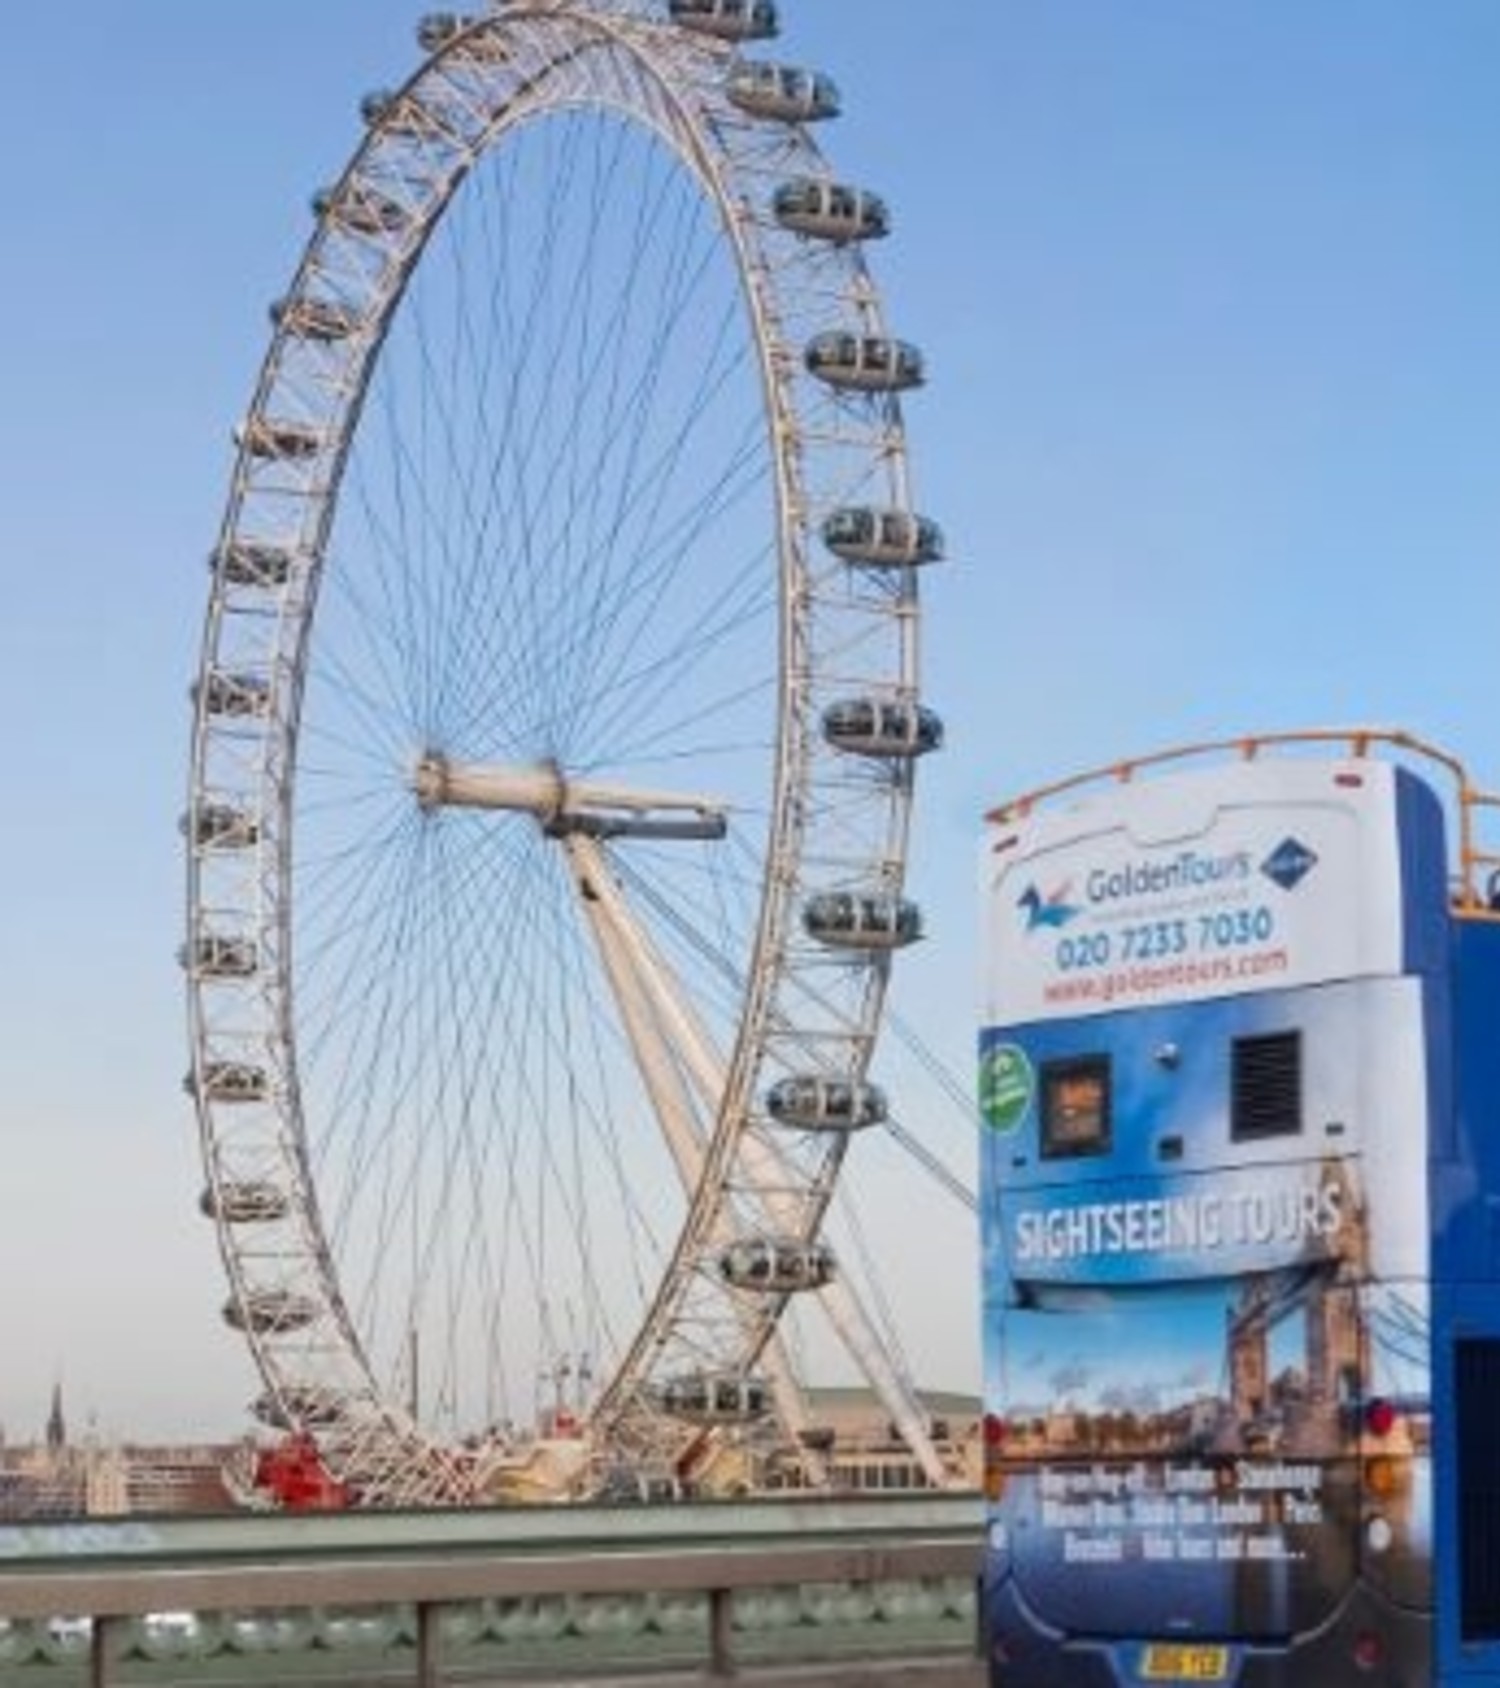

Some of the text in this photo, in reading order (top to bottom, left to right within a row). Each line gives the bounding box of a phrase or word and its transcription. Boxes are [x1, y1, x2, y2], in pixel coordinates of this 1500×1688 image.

[1055, 933, 1111, 971] 020
[1119, 920, 1187, 960] 7233
[1198, 905, 1273, 950] 7030
[1043, 947, 1289, 1003] www.goldentours.com
[1016, 1180, 1341, 1259] SIGHTSEEING TOURS
